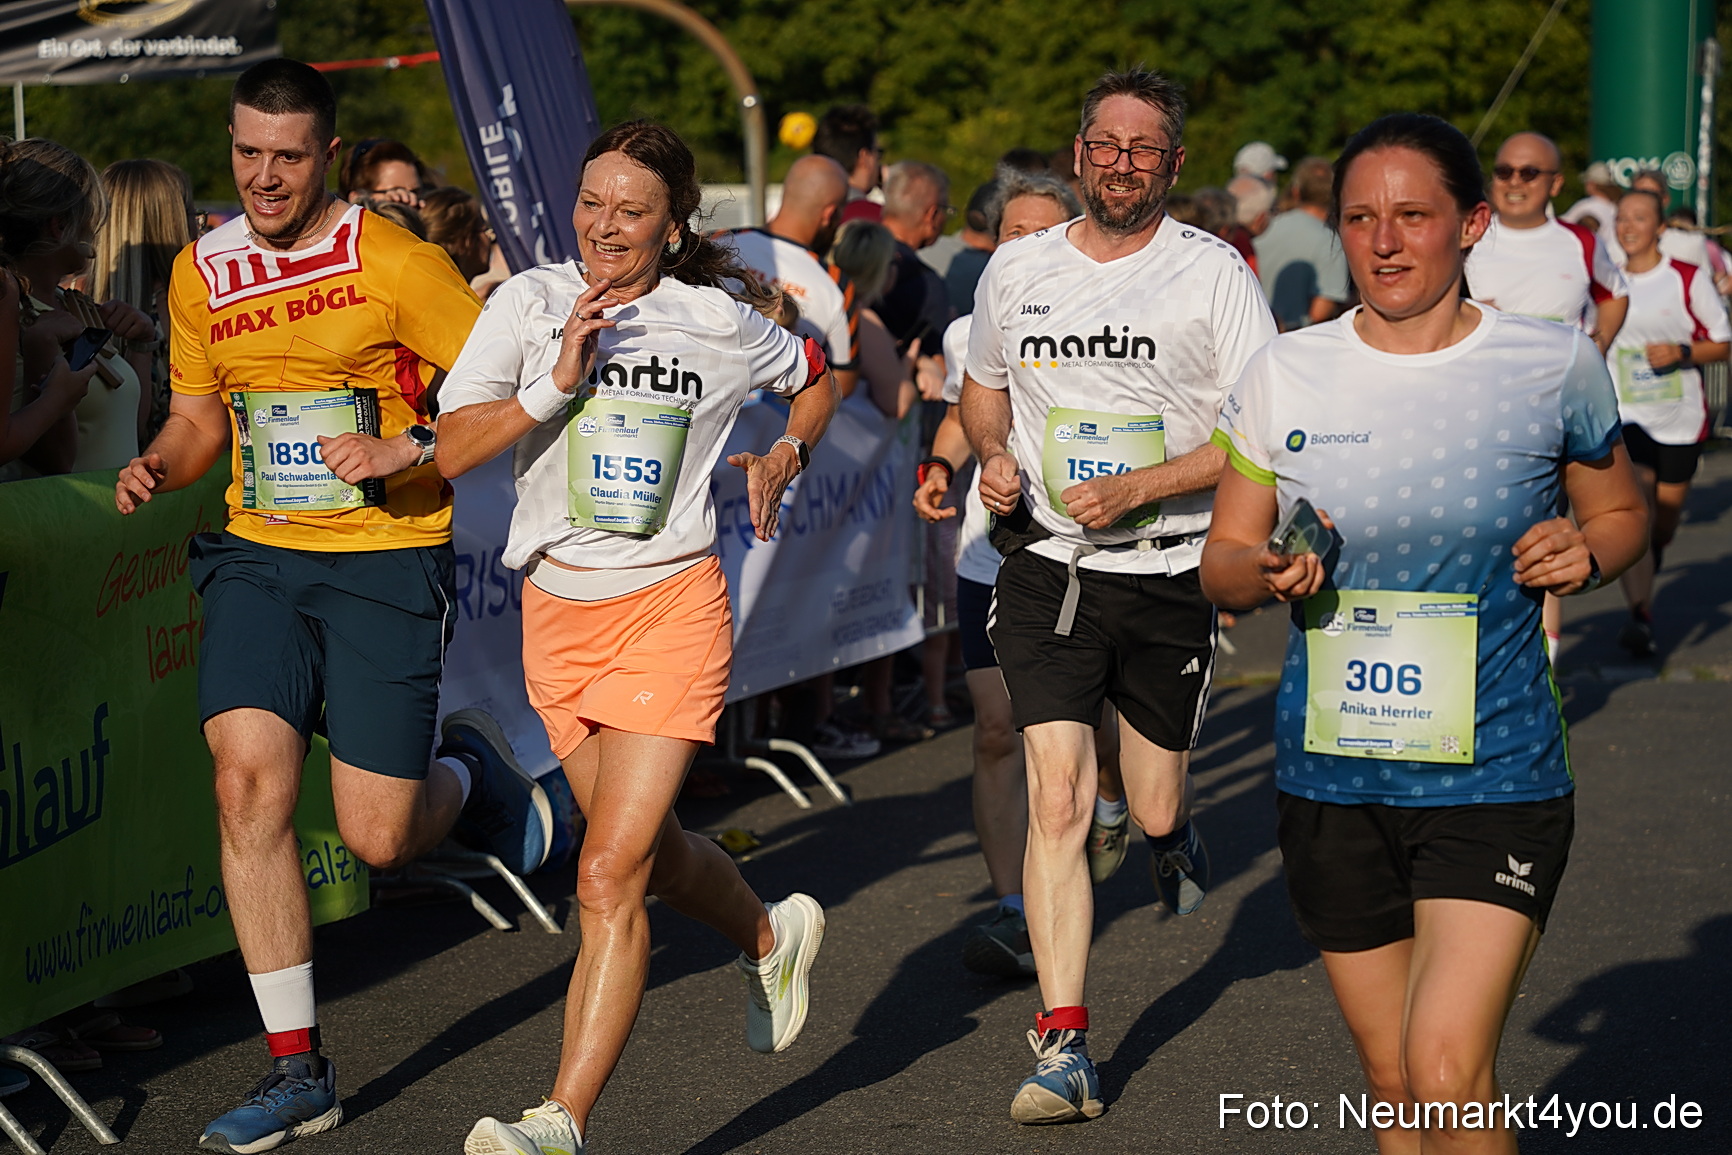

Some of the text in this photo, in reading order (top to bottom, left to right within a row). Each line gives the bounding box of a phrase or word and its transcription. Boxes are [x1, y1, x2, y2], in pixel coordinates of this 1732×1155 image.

[38, 35, 243, 59] Ein Ort, der verbindet.
[479, 120, 521, 236] OBILE
[210, 284, 368, 346] MAX BÖGL
[1020, 304, 1051, 315] JAKO
[551, 328, 564, 340] JA
[1020, 325, 1156, 361] martin
[1114, 361, 1156, 369] TECHNOLOGY
[588, 355, 703, 400] artin
[601, 389, 624, 397] METAL
[625, 389, 660, 401] FORMING
[268, 414, 300, 424] Firmenlauf
[363, 416, 371, 436] CTORY
[598, 425, 640, 435] Firmenlauf
[1073, 433, 1110, 442] Firmenlauf
[268, 441, 324, 466] 1830
[261, 471, 338, 482] Paul Schwabenla
[592, 454, 662, 485] 1553
[367, 478, 375, 498] HIL
[590, 486, 662, 504] Claudia Müller
[719, 463, 897, 559] FRCHMANN
[96, 504, 211, 618] Gesund
[146, 591, 204, 684] lauf
[1347, 623, 1393, 632] Firmenlauf
[1346, 659, 1422, 696] 306
[1339, 701, 1433, 719] Anika Herrler
[1494, 871, 1536, 897] erima
